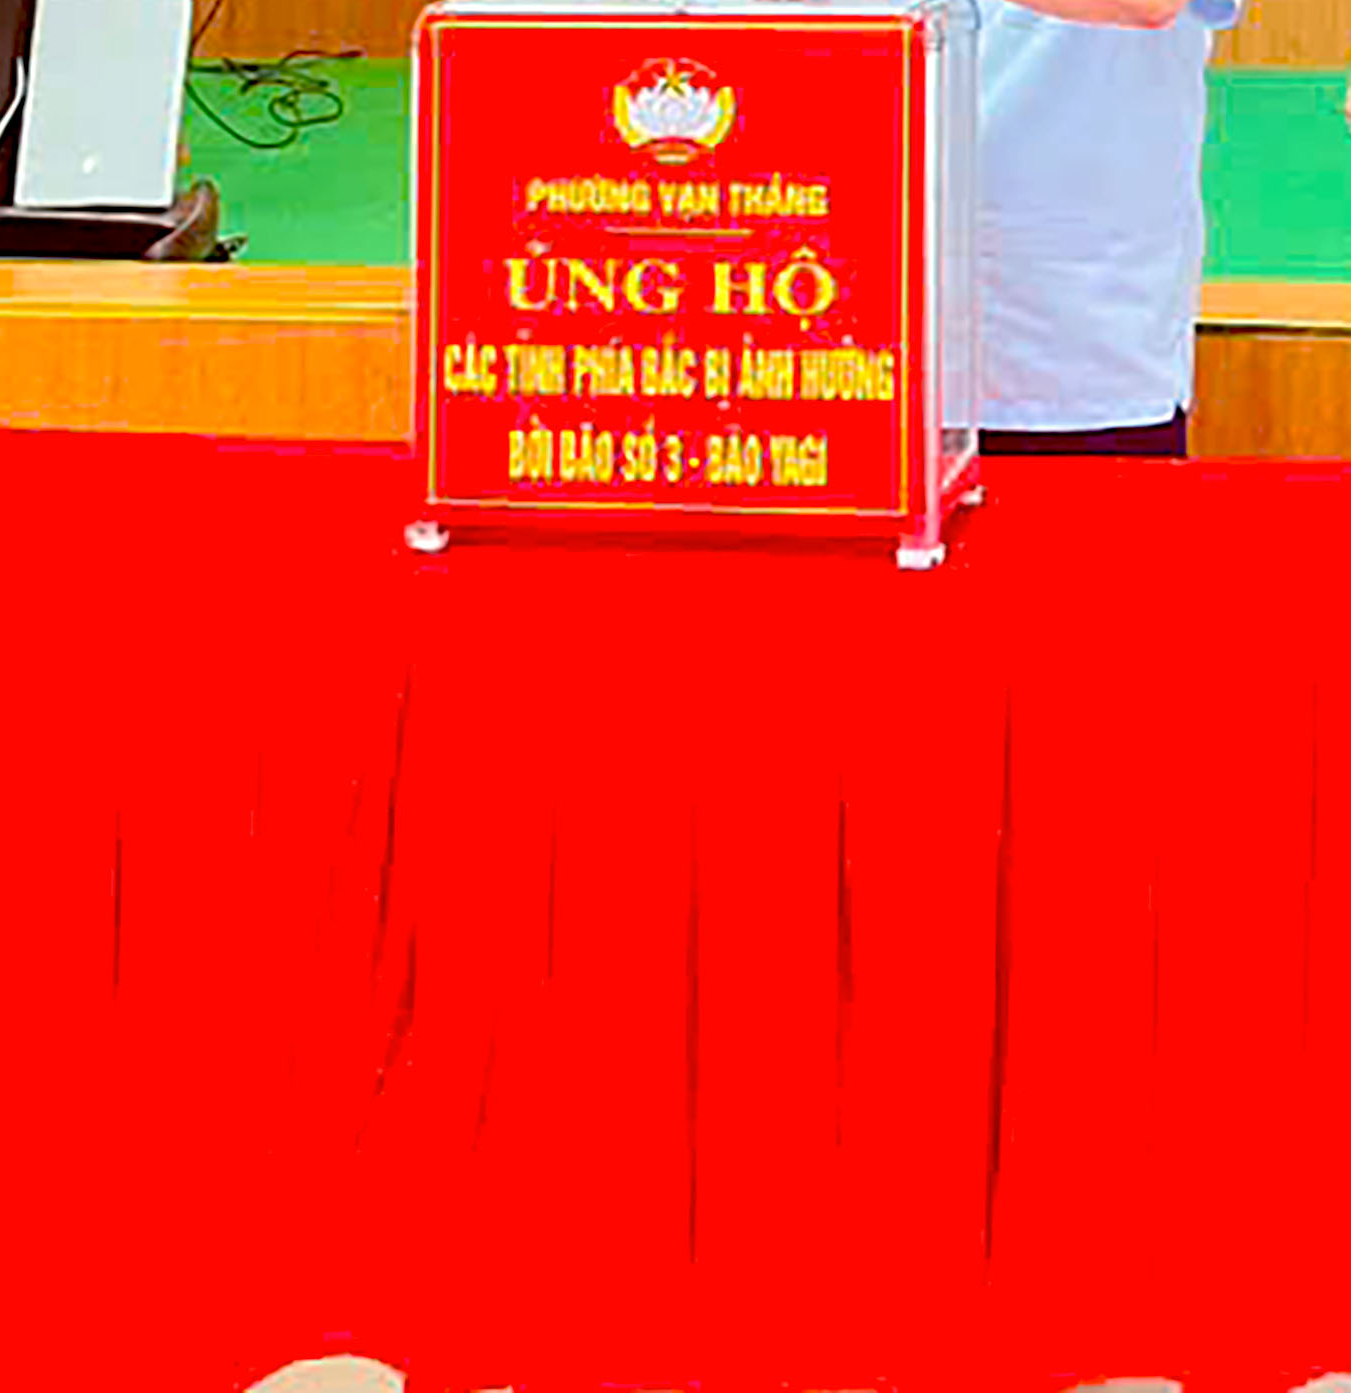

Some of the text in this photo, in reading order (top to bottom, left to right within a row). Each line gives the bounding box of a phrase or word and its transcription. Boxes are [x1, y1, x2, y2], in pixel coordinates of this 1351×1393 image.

[504, 239, 838, 331] ỦNG HỘ
[443, 332, 498, 396] CÁC
[663, 433, 684, 482] 3
[768, 434, 829, 486] YAGI
